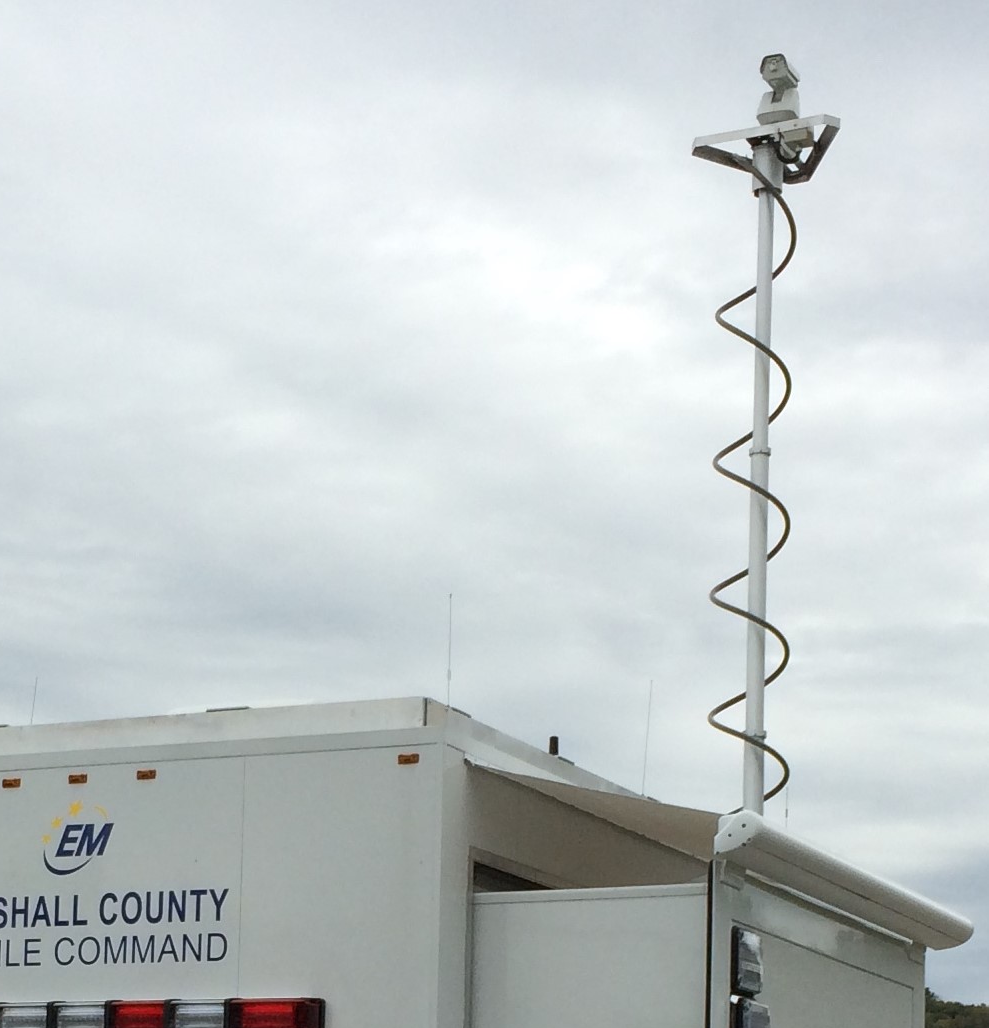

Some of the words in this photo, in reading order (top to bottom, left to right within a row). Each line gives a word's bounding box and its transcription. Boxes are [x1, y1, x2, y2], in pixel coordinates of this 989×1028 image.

[54, 822, 115, 858] EM
[99, 888, 230, 926] COUNTY
[54, 932, 229, 967] COMMAND
